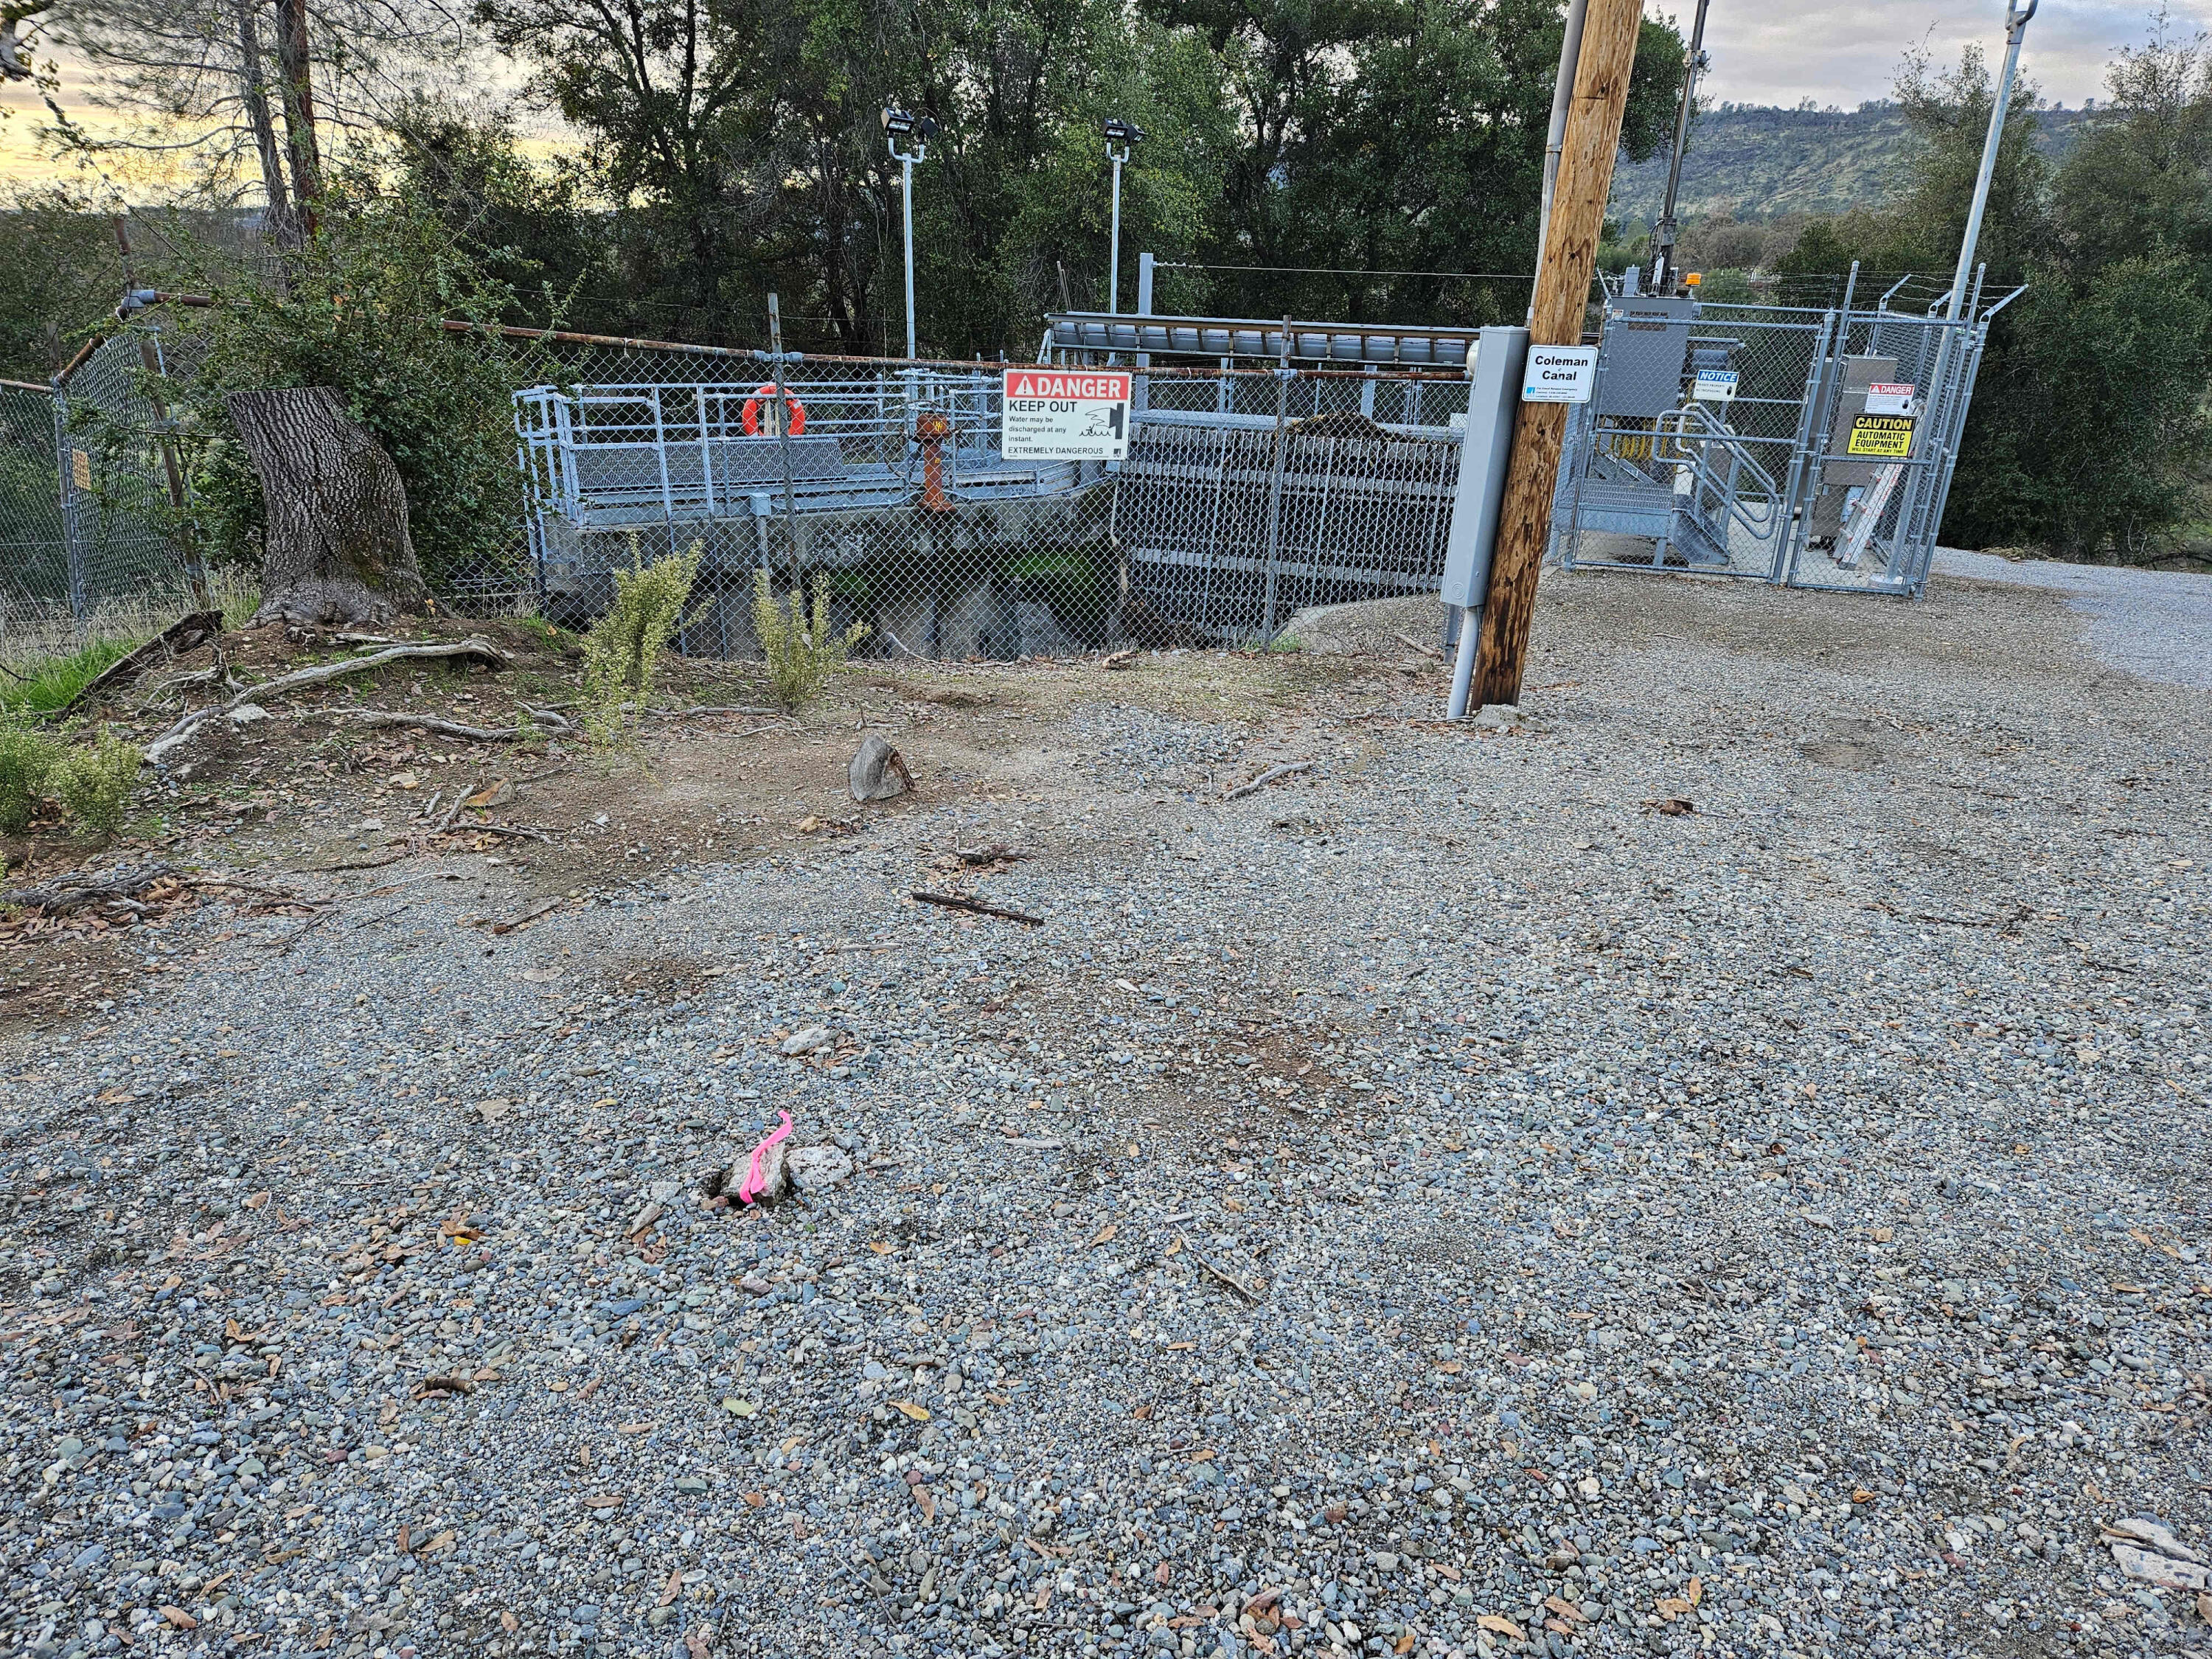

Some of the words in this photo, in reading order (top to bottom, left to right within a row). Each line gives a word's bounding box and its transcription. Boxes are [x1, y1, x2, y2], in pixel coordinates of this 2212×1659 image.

[1535, 355, 1588, 366] Coleman
[1542, 370, 1576, 380] Canal
[1700, 372, 1737, 382] NOTICE
[1037, 377, 1121, 398] DANGER
[1881, 385, 1912, 394] DANGER
[1009, 400, 1045, 412] KEEP
[1049, 401, 1077, 413] OUT
[1855, 417, 1913, 430] CAUTION
[1009, 426, 1046, 434] discharged
[1857, 431, 1905, 441] AUTOMATIC
[1854, 439, 1904, 449] EQUIPMENT
